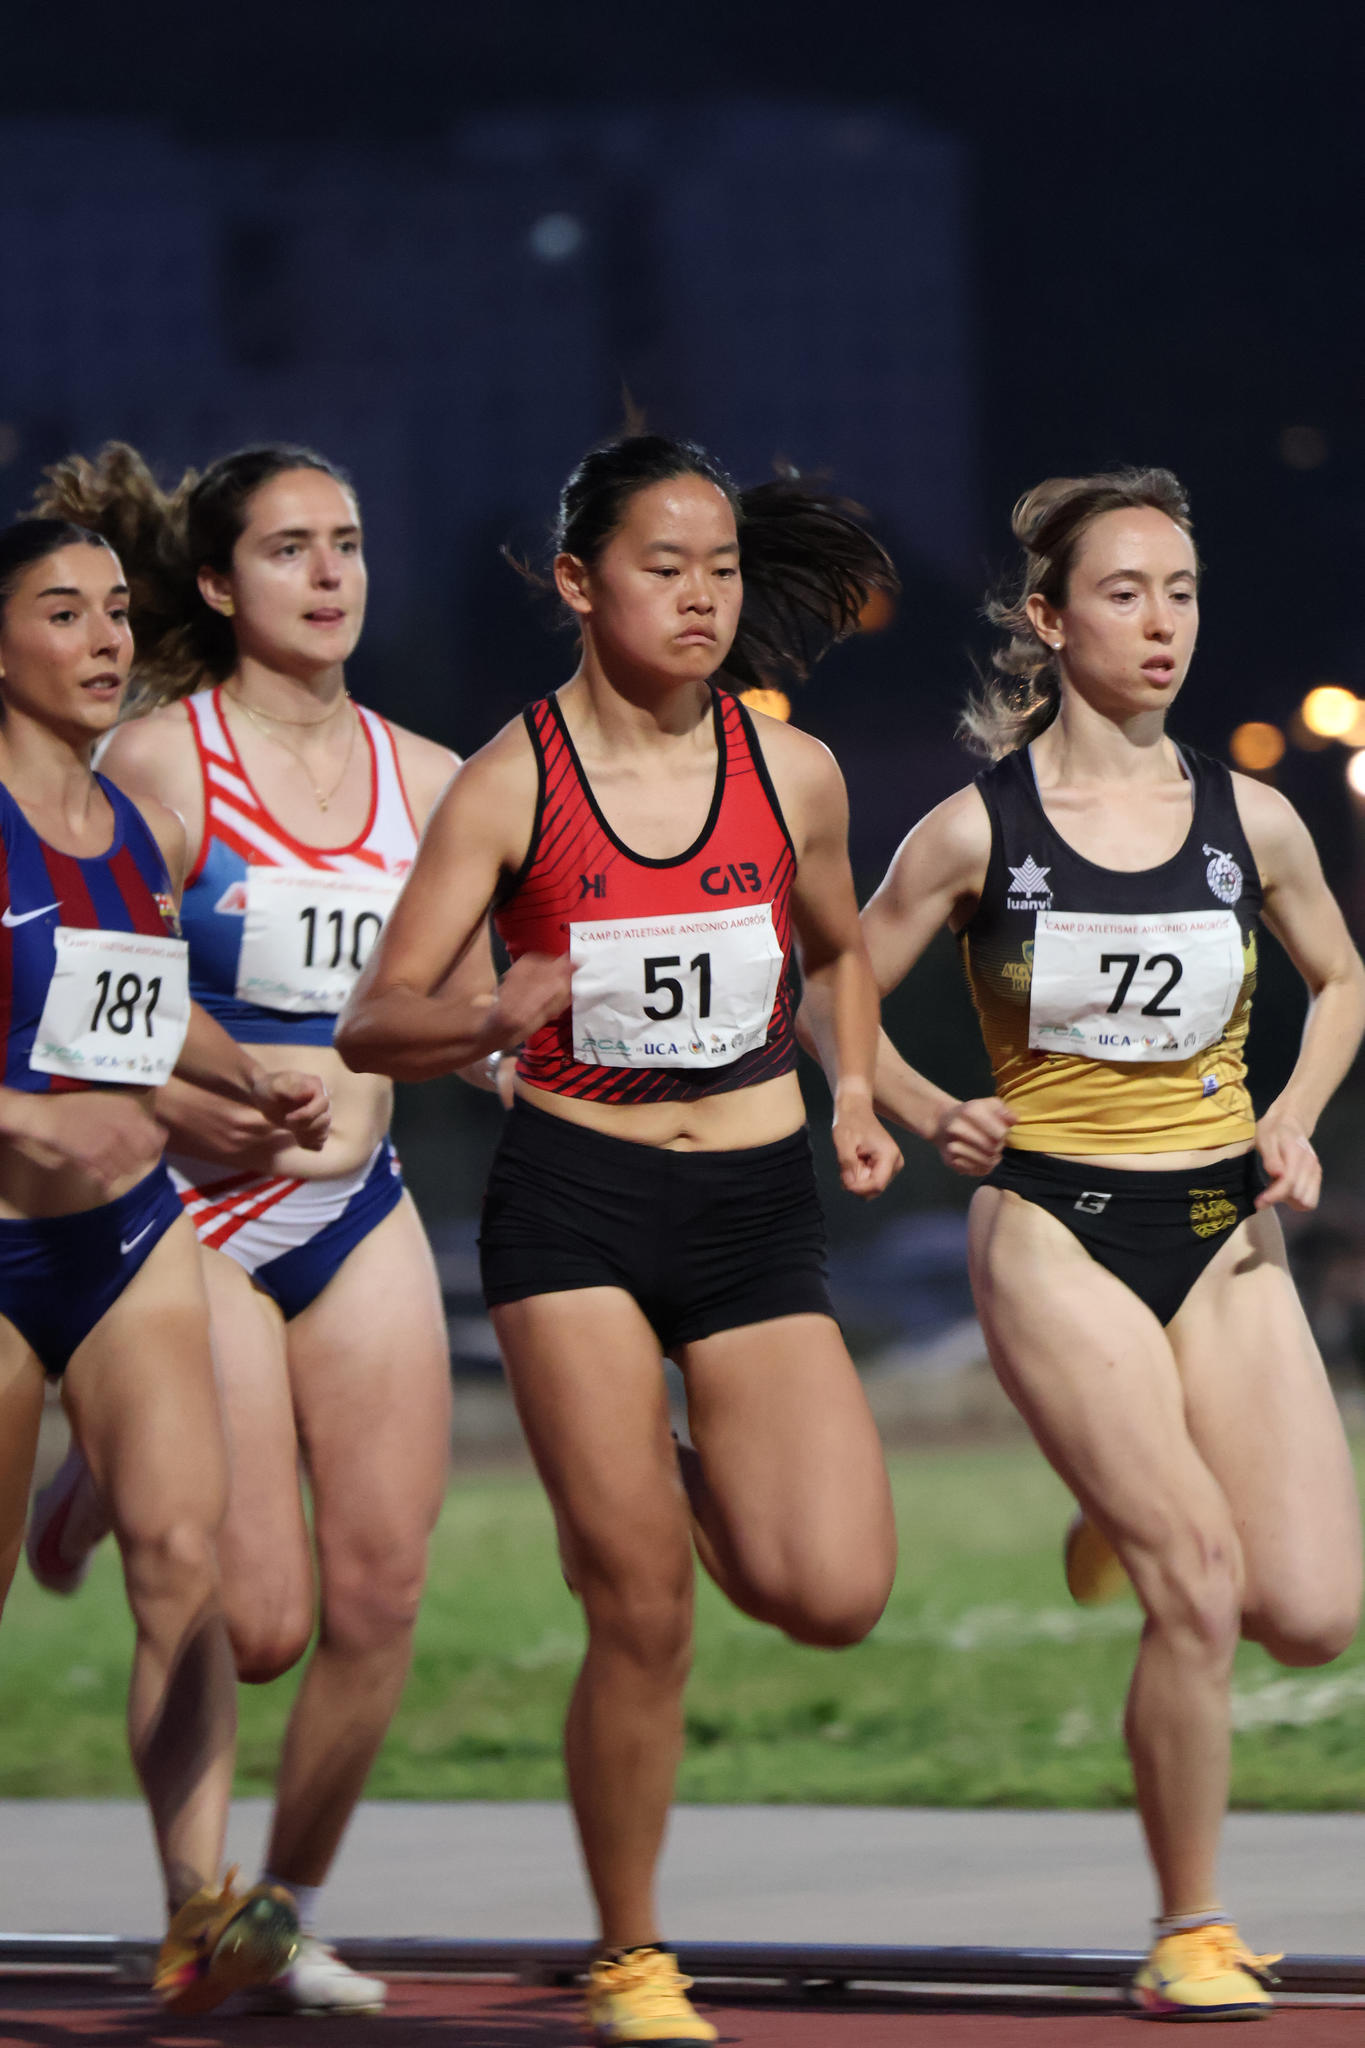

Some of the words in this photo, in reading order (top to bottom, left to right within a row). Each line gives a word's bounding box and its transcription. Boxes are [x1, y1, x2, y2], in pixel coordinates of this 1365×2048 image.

[580, 930, 611, 942] CAMP
[680, 920, 729, 935] ANTONIO
[1046, 921, 1075, 931] CAMP
[1142, 923, 1186, 934] ANTONIO
[643, 952, 711, 1021] 51
[1100, 954, 1183, 1017] 72
[90, 970, 162, 1037] 181
[644, 1043, 679, 1055] UCA
[1099, 1034, 1131, 1046] UCA
